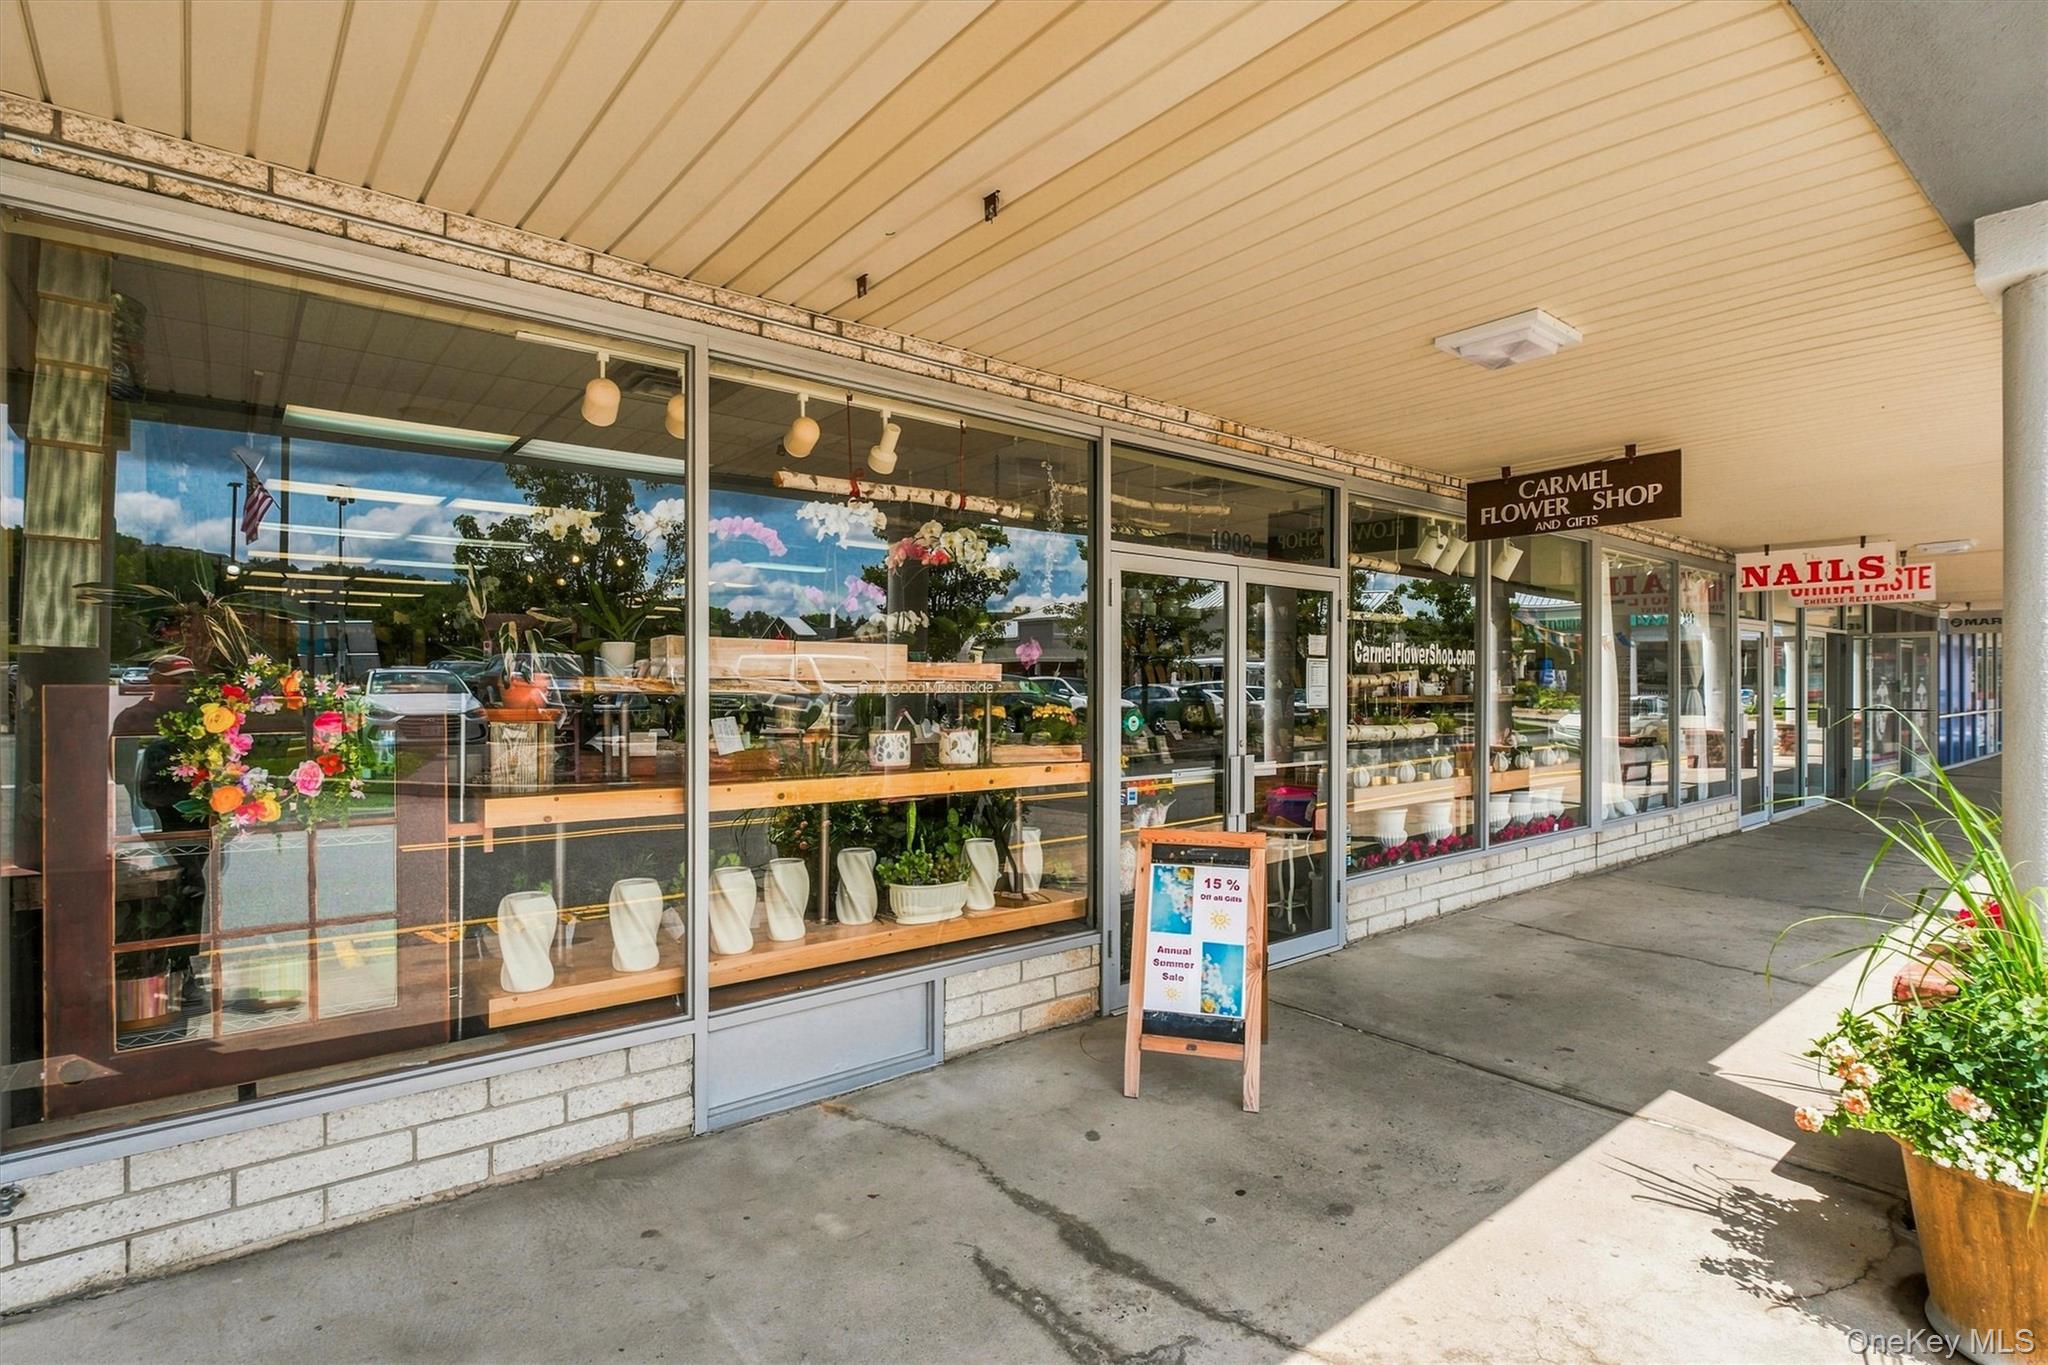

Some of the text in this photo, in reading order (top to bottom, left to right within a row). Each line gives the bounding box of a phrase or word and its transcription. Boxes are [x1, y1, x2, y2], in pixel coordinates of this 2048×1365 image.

[1518, 468, 1614, 499] CARMEL
[1480, 483, 1663, 526] FLOWER SHOP
[1535, 514, 1599, 531] AND GIFTS
[1741, 554, 1886, 588] NAILS
[1803, 592, 1916, 606] CHINESE RESTAURANT
[1354, 640, 1476, 666] CarmelFlowerShop.com
[1204, 877, 1240, 891] 15 %
[1157, 945, 1192, 955] Annual
[1162, 972, 1185, 982] Sale
